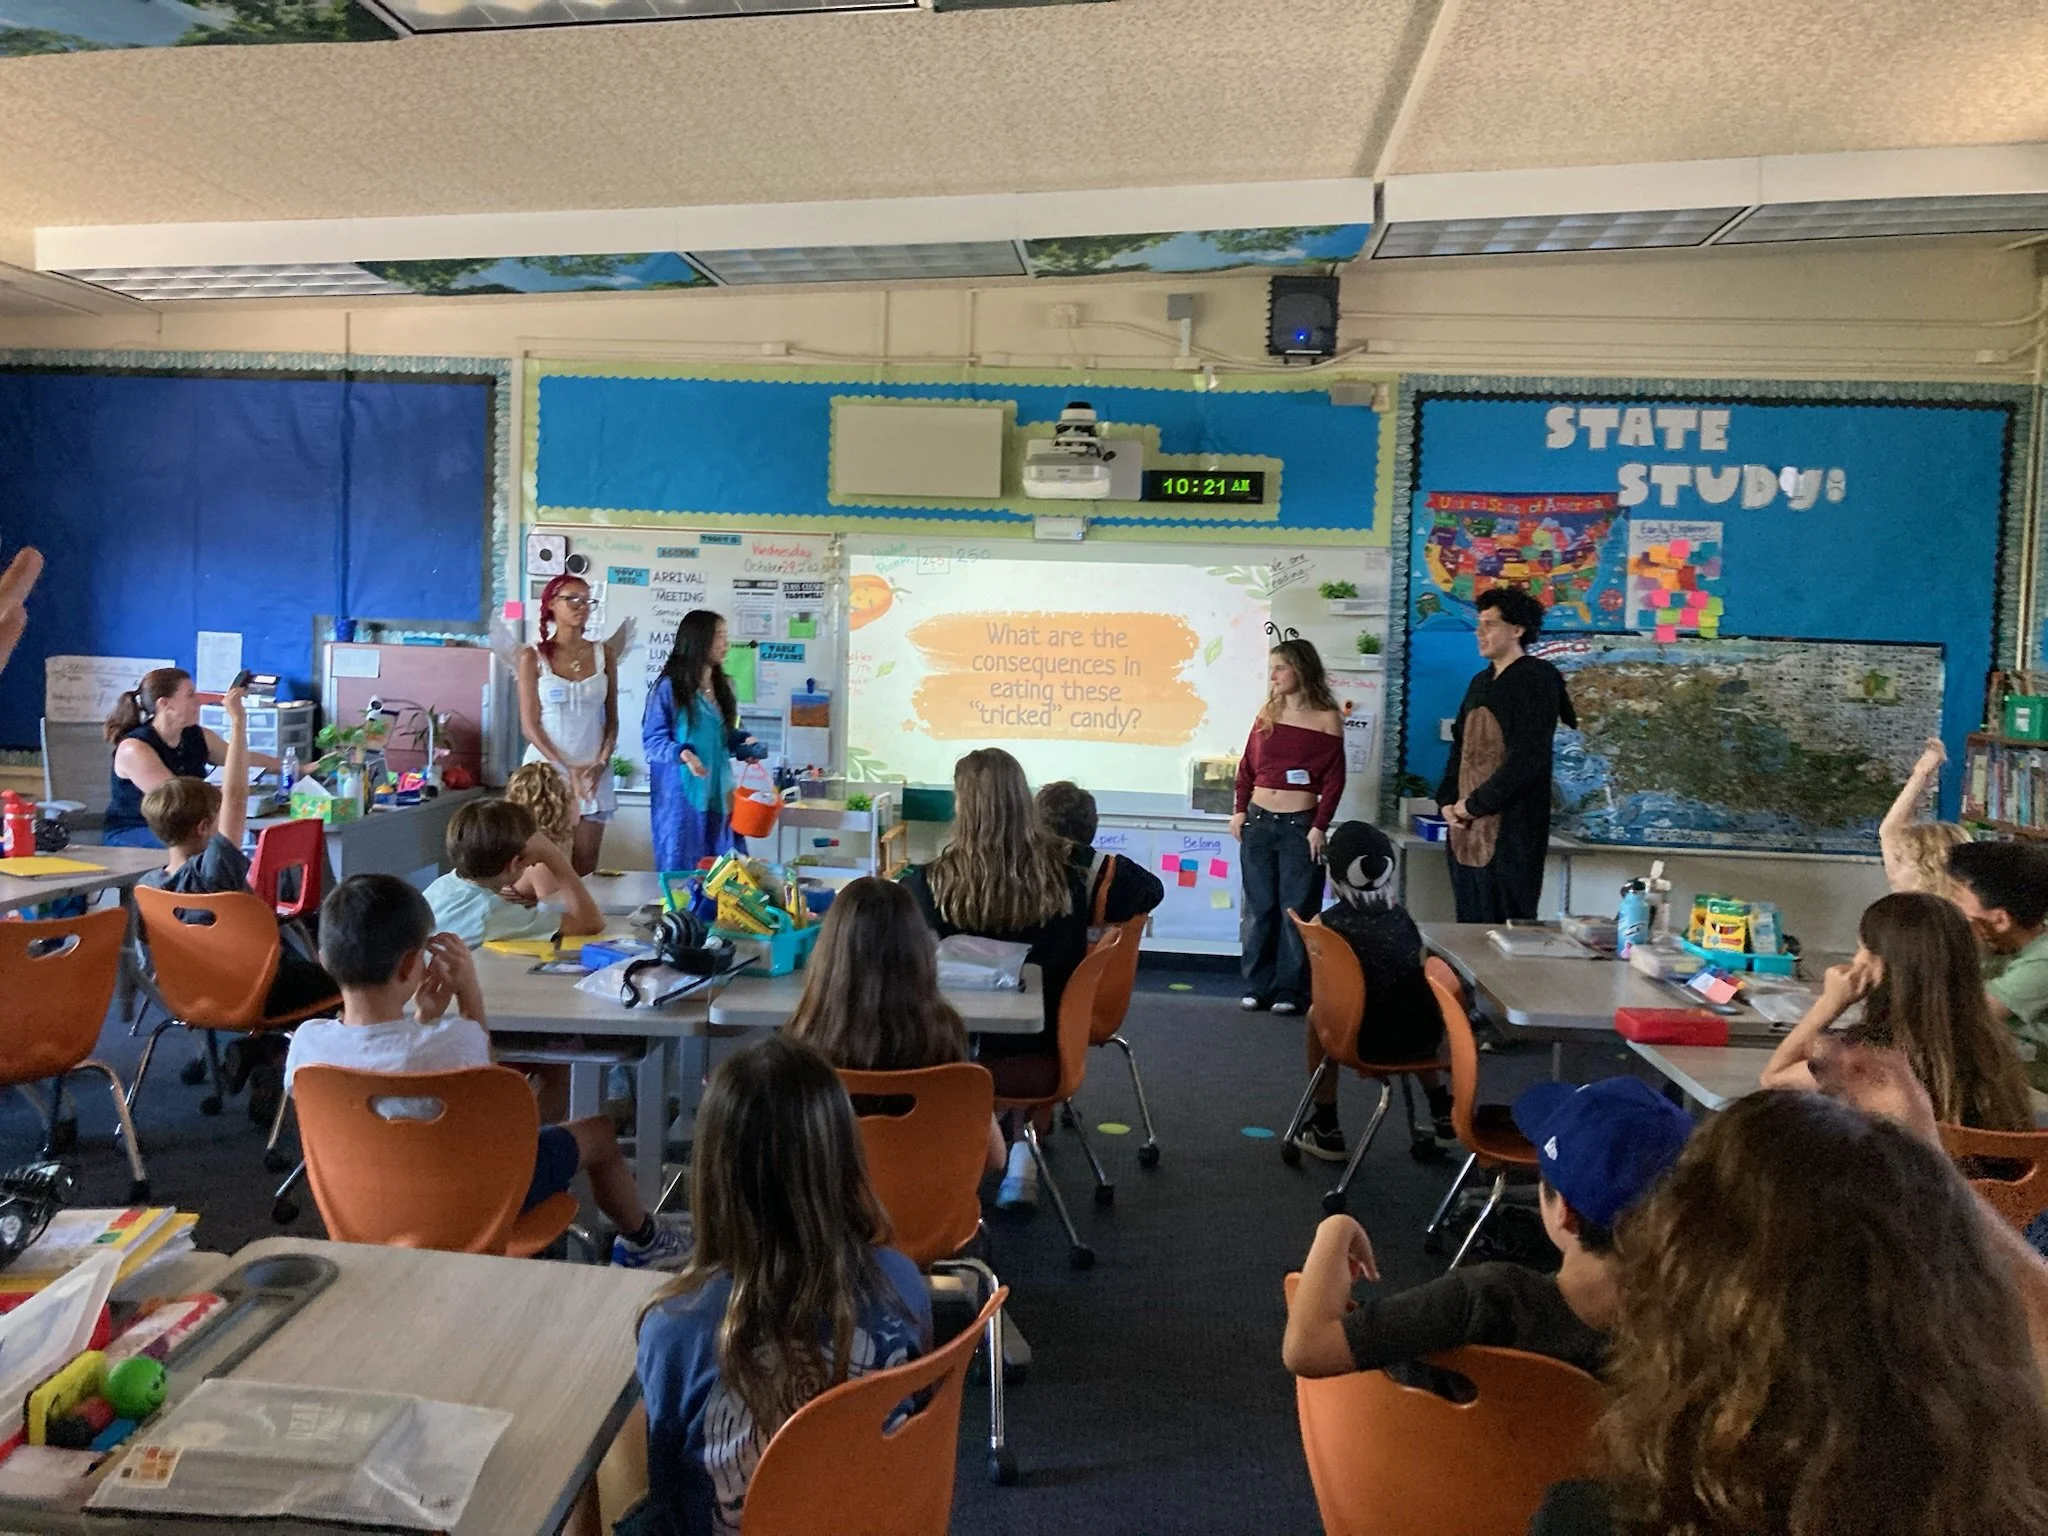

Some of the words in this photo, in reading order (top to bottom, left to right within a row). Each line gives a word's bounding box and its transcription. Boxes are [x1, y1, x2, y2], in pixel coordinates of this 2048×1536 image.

[1545, 406, 1731, 451] STATE
[1163, 478, 1226, 495] 10:21
[1231, 479, 1250, 492] AM
[752, 542, 813, 558] Wednesday
[956, 548, 992, 564] 250
[744, 557, 783, 574] October
[653, 571, 706, 584] ARRIVAL
[656, 591, 704, 602] MEETING
[986, 622, 1040, 646] What
[1048, 630, 1083, 647] are
[1091, 627, 1128, 648] the
[649, 650, 671, 660] LUN
[972, 654, 1116, 681] consequences
[1124, 656, 1141, 676] in
[990, 680, 1053, 706] eating
[1061, 681, 1122, 702] these
[1071, 709, 1142, 736] candy?
[1183, 836, 1222, 854] Belong
